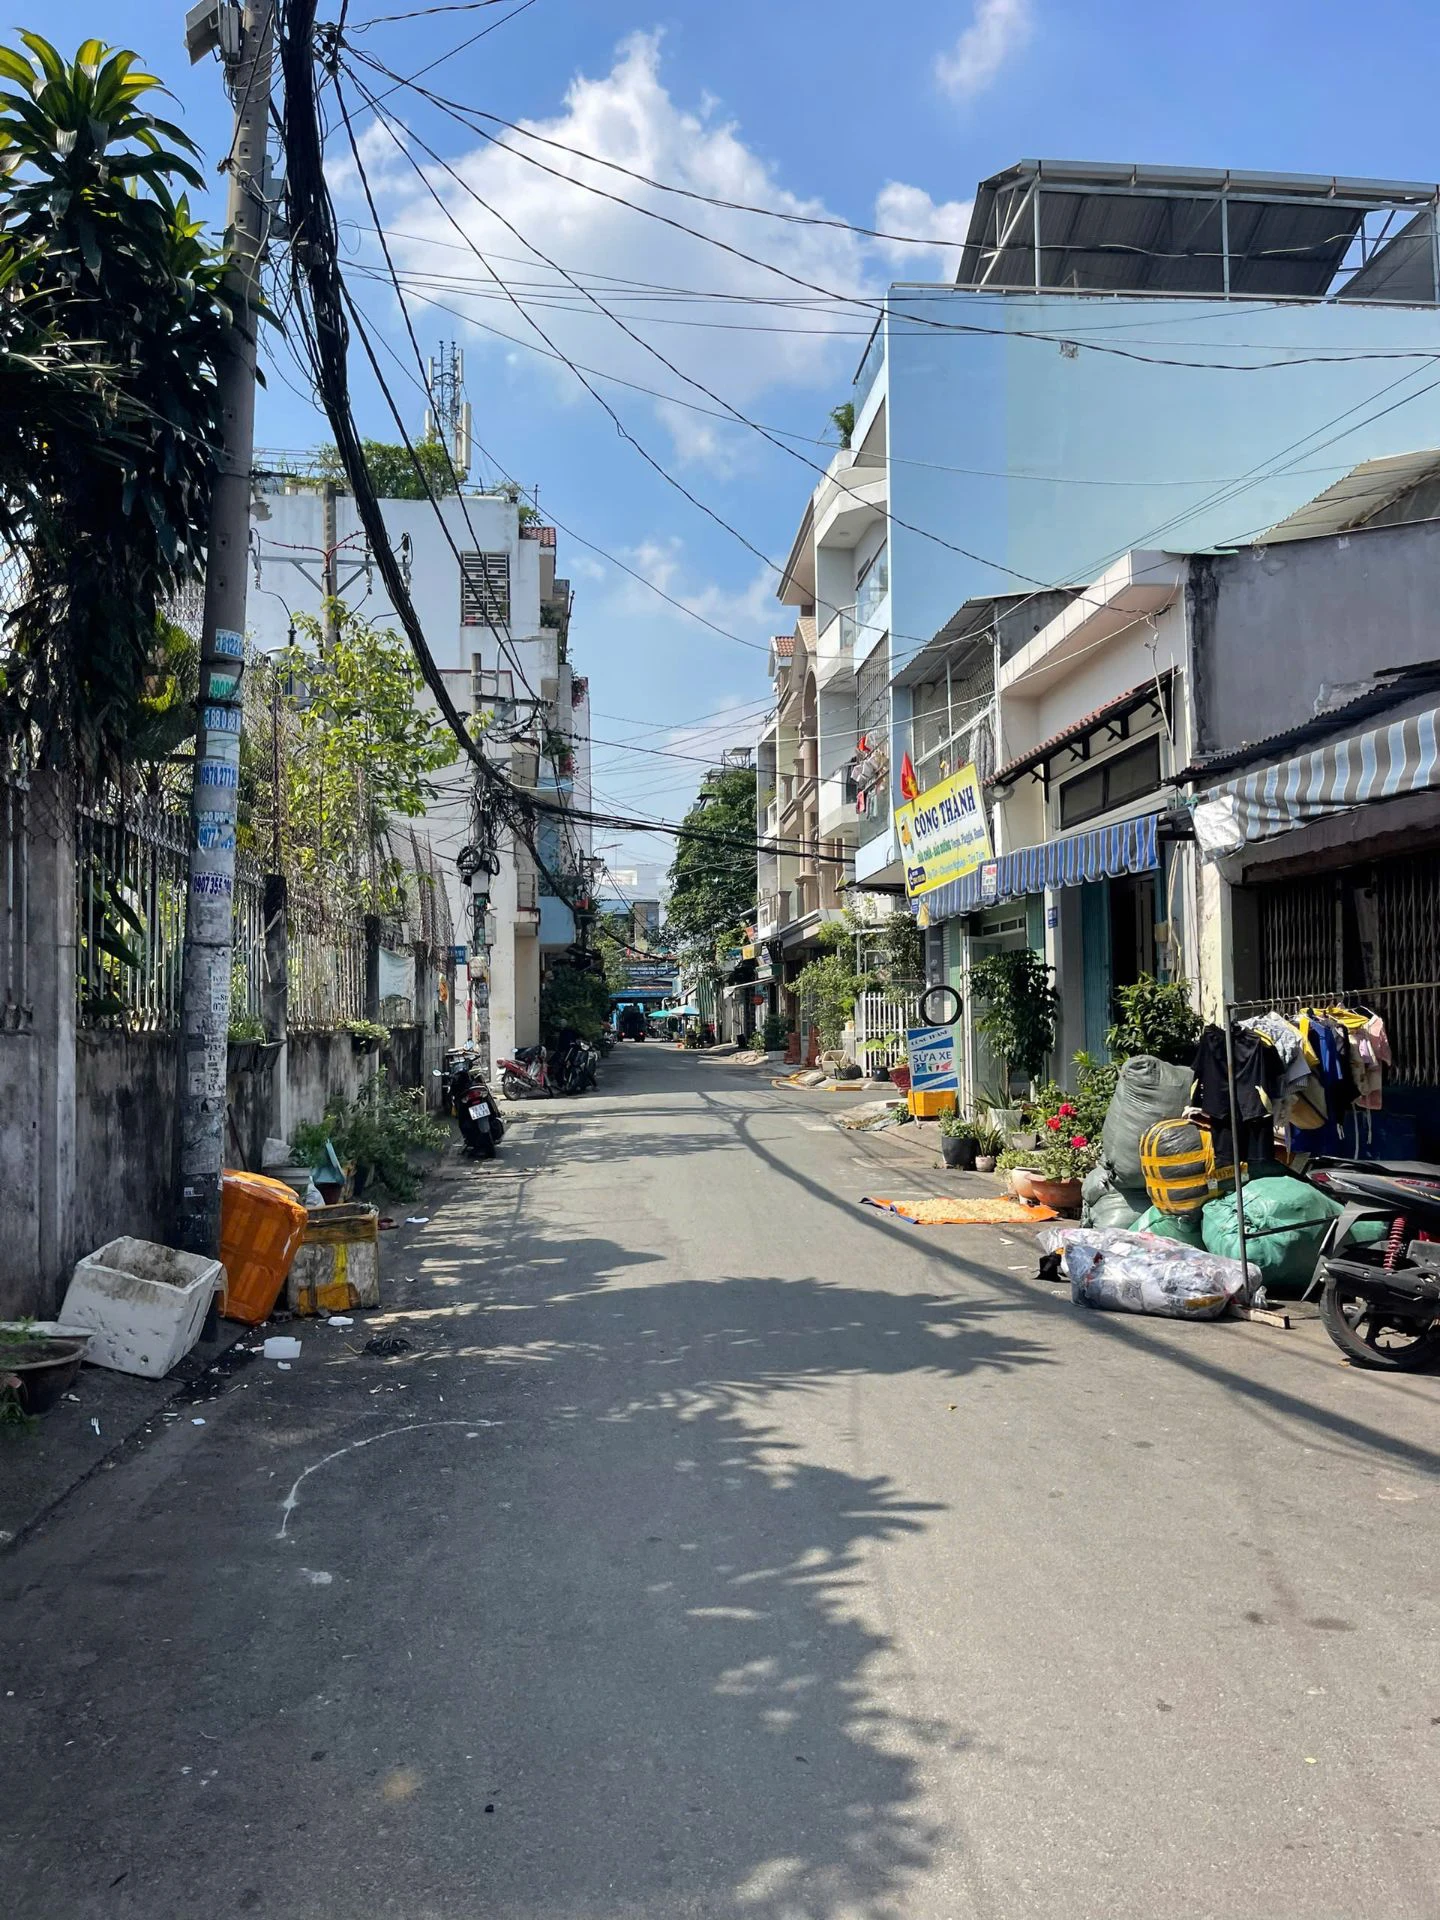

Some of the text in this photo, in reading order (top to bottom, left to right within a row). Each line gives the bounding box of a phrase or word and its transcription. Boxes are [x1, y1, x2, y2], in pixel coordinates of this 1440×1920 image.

[914, 785, 977, 838] CÔNG THÀNH
[913, 1050, 952, 1063] SỬA XE
